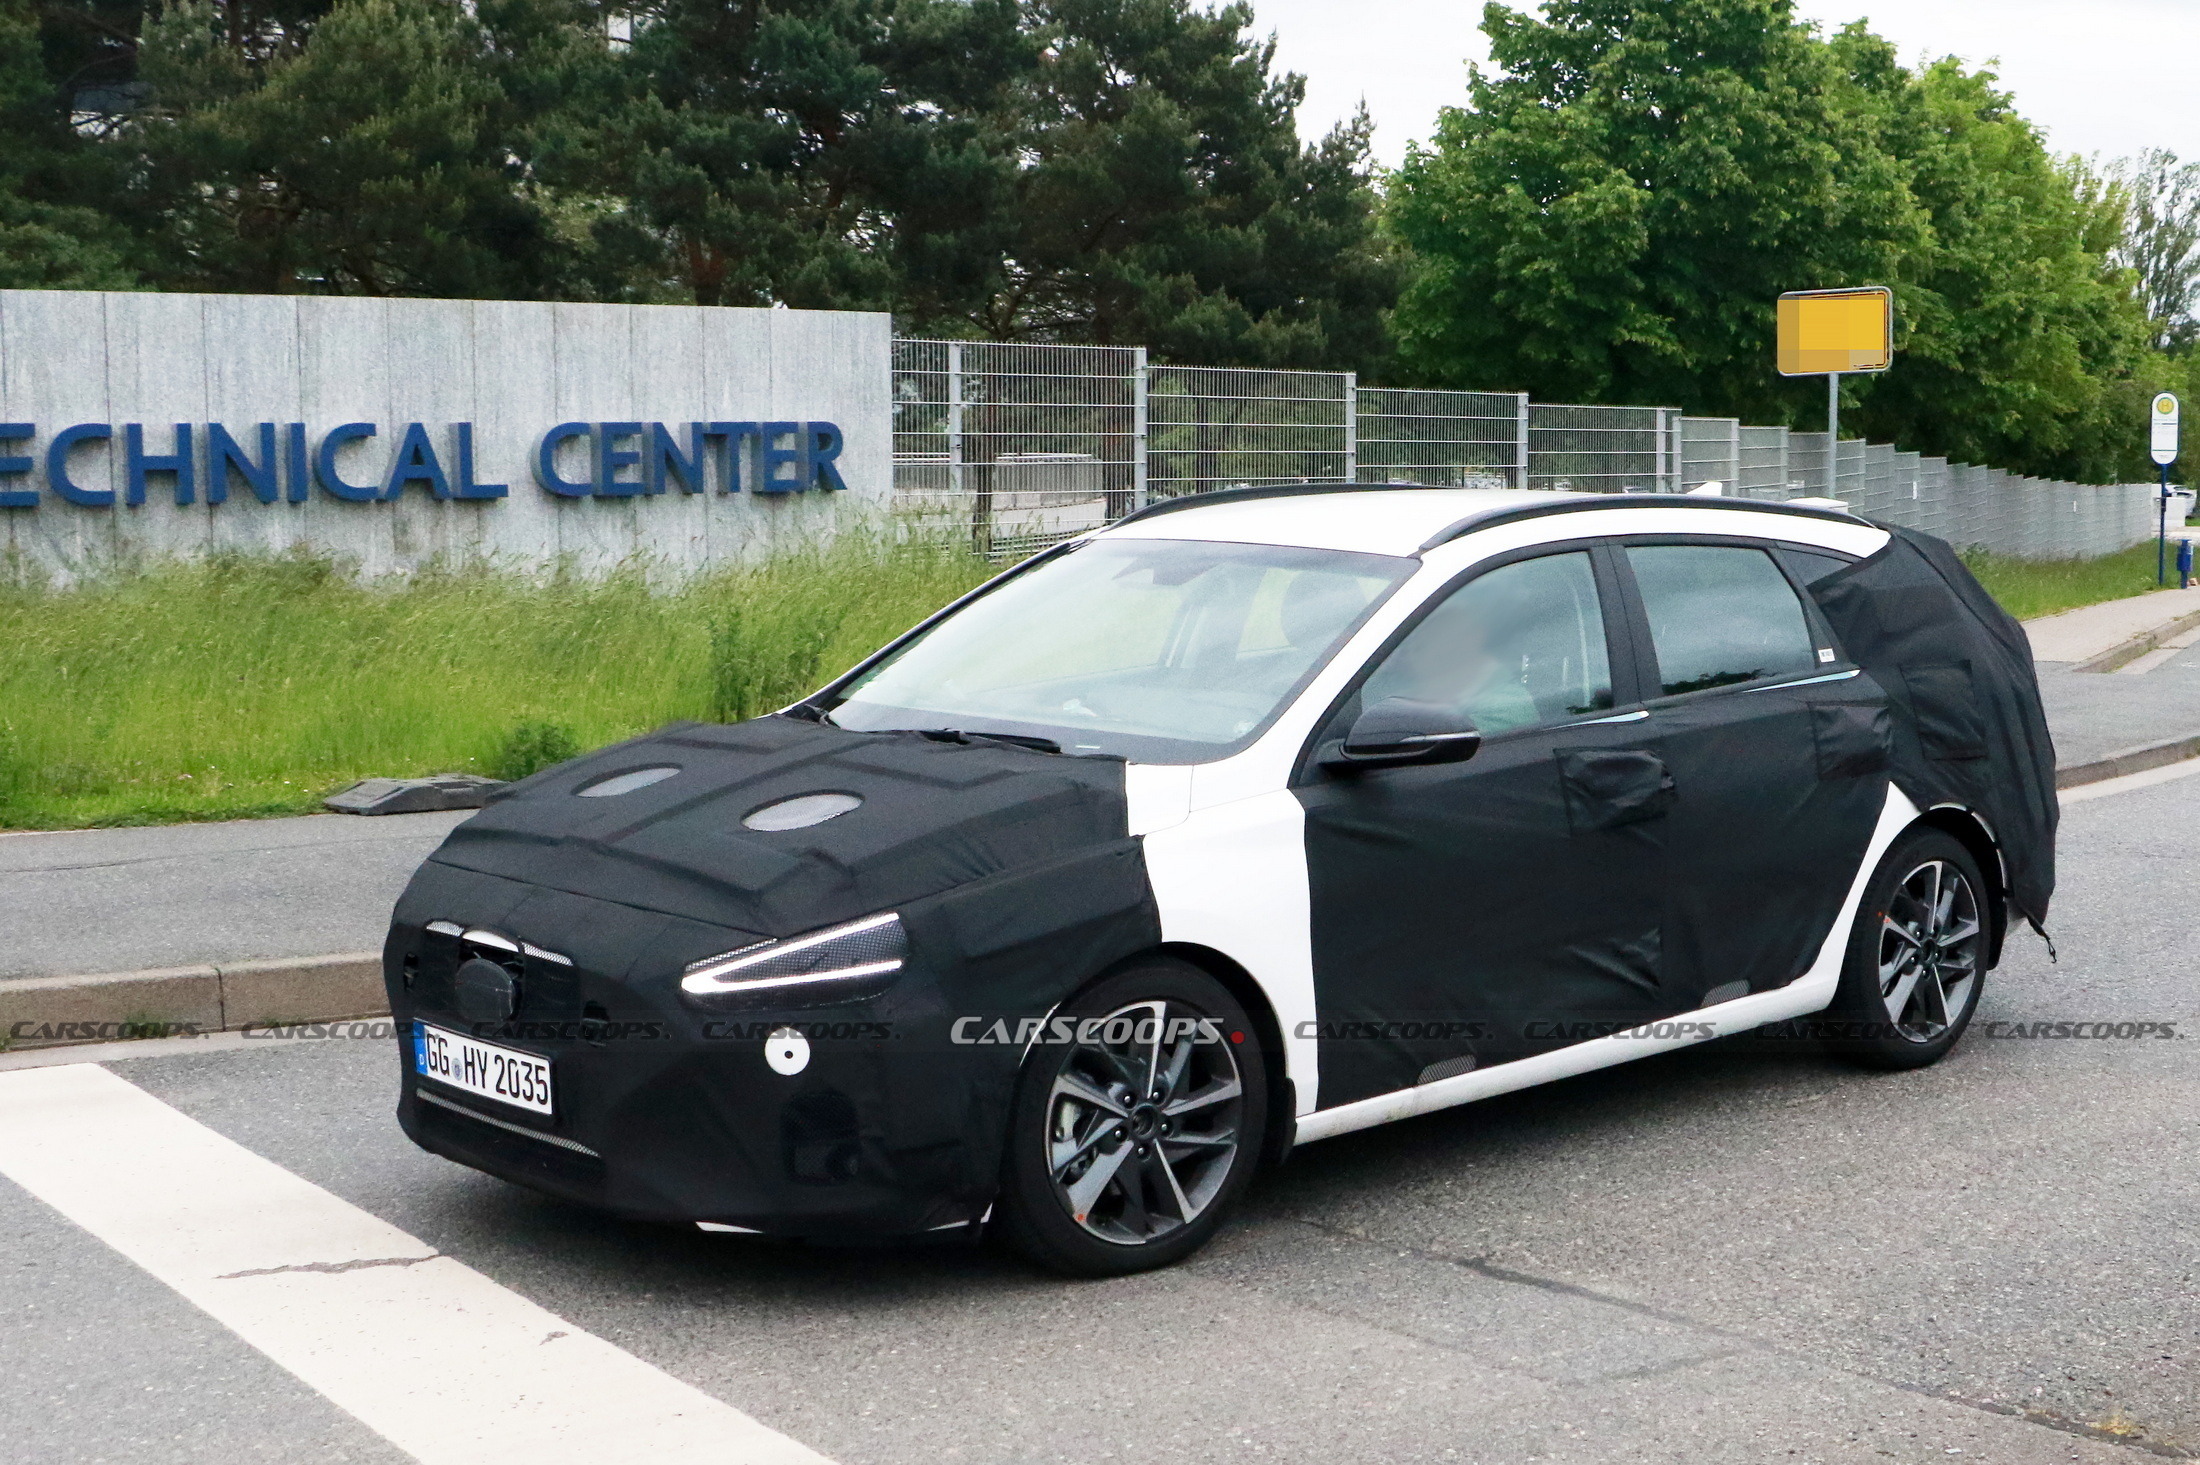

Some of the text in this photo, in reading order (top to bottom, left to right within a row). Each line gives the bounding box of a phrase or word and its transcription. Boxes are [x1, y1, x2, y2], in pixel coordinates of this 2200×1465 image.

[530, 421, 847, 497] CENTER
[427, 1033, 549, 1105] GG HY 2035
